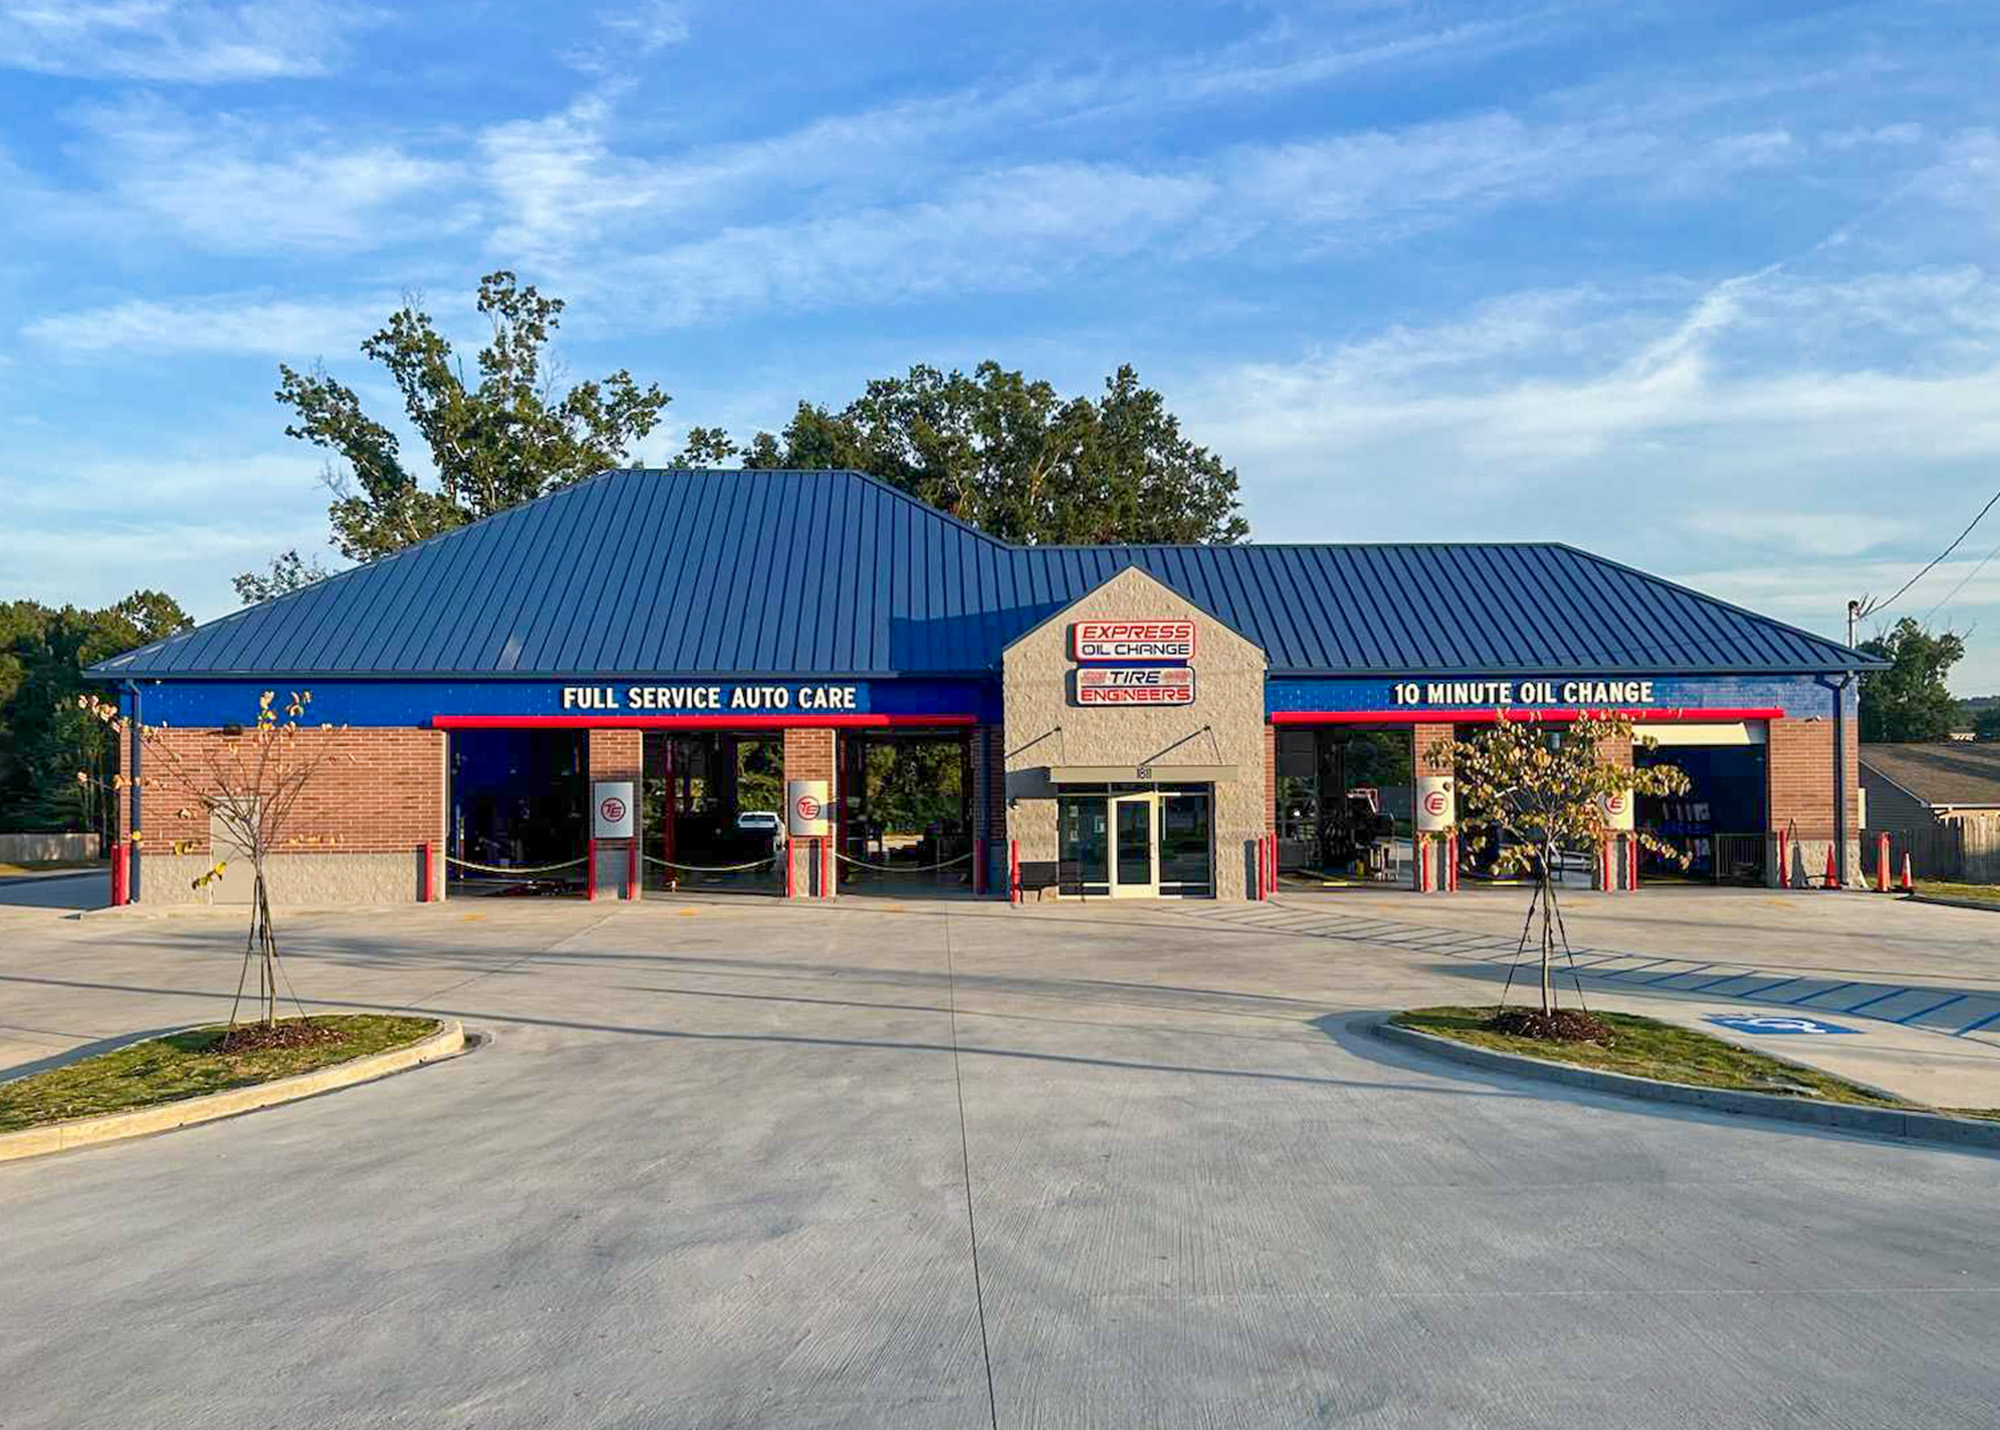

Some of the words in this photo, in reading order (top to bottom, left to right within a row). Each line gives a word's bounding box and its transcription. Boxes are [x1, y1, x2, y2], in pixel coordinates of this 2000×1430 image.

[1082, 625, 1191, 639] EXPRESS
[1082, 644, 1111, 656] OIL
[1114, 644, 1190, 656] CHANGE
[1111, 671, 1161, 684] TIRE
[563, 687, 619, 709] FULL
[628, 686, 721, 709] SERVICE
[731, 687, 789, 709] AUTO
[798, 687, 856, 709] CARE
[1081, 689, 1190, 702] ENGINEERS
[1394, 683, 1420, 705] 10
[1427, 683, 1513, 704] MINUTE
[1520, 682, 1557, 704] OIL
[1563, 682, 1655, 704] CHANGE
